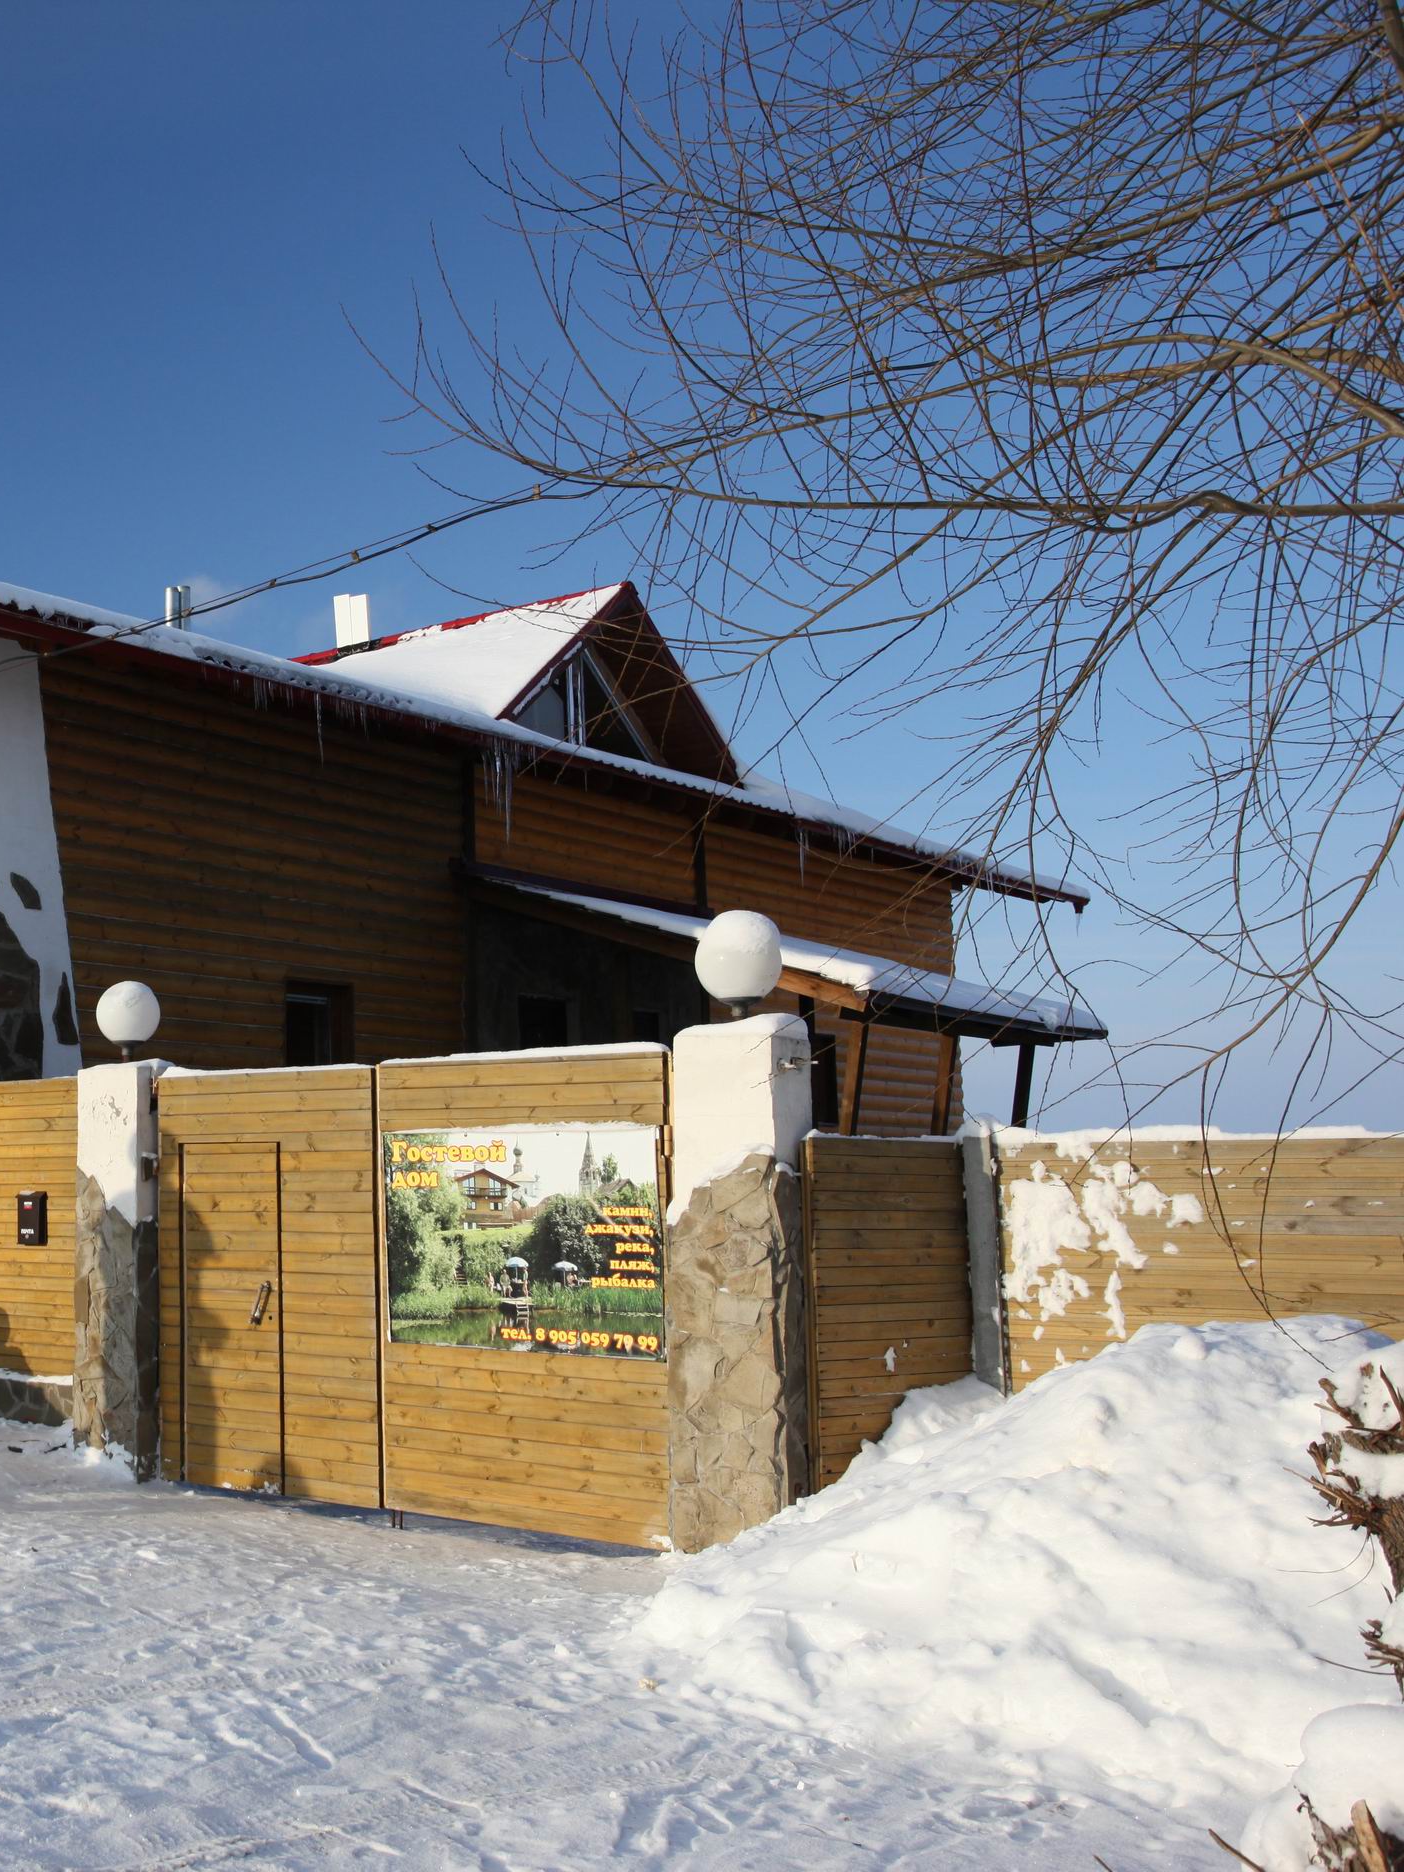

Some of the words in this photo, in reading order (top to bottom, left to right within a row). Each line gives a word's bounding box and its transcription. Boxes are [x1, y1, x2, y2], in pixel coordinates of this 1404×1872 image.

[392, 1140, 506, 1162] Гостевой
[392, 1171, 438, 1188] дом
[603, 1207, 653, 1219] камин,
[585, 1224, 654, 1238] джакузи,
[615, 1242, 654, 1255] река,
[610, 1260, 654, 1273] пляж,
[591, 1273, 656, 1289] рыбалка
[501, 1328, 532, 1341] тел.
[535, 1327, 546, 1341] 8
[548, 1329, 578, 1345] 905
[580, 1332, 610, 1347] 059
[637, 1335, 658, 1351] 99
